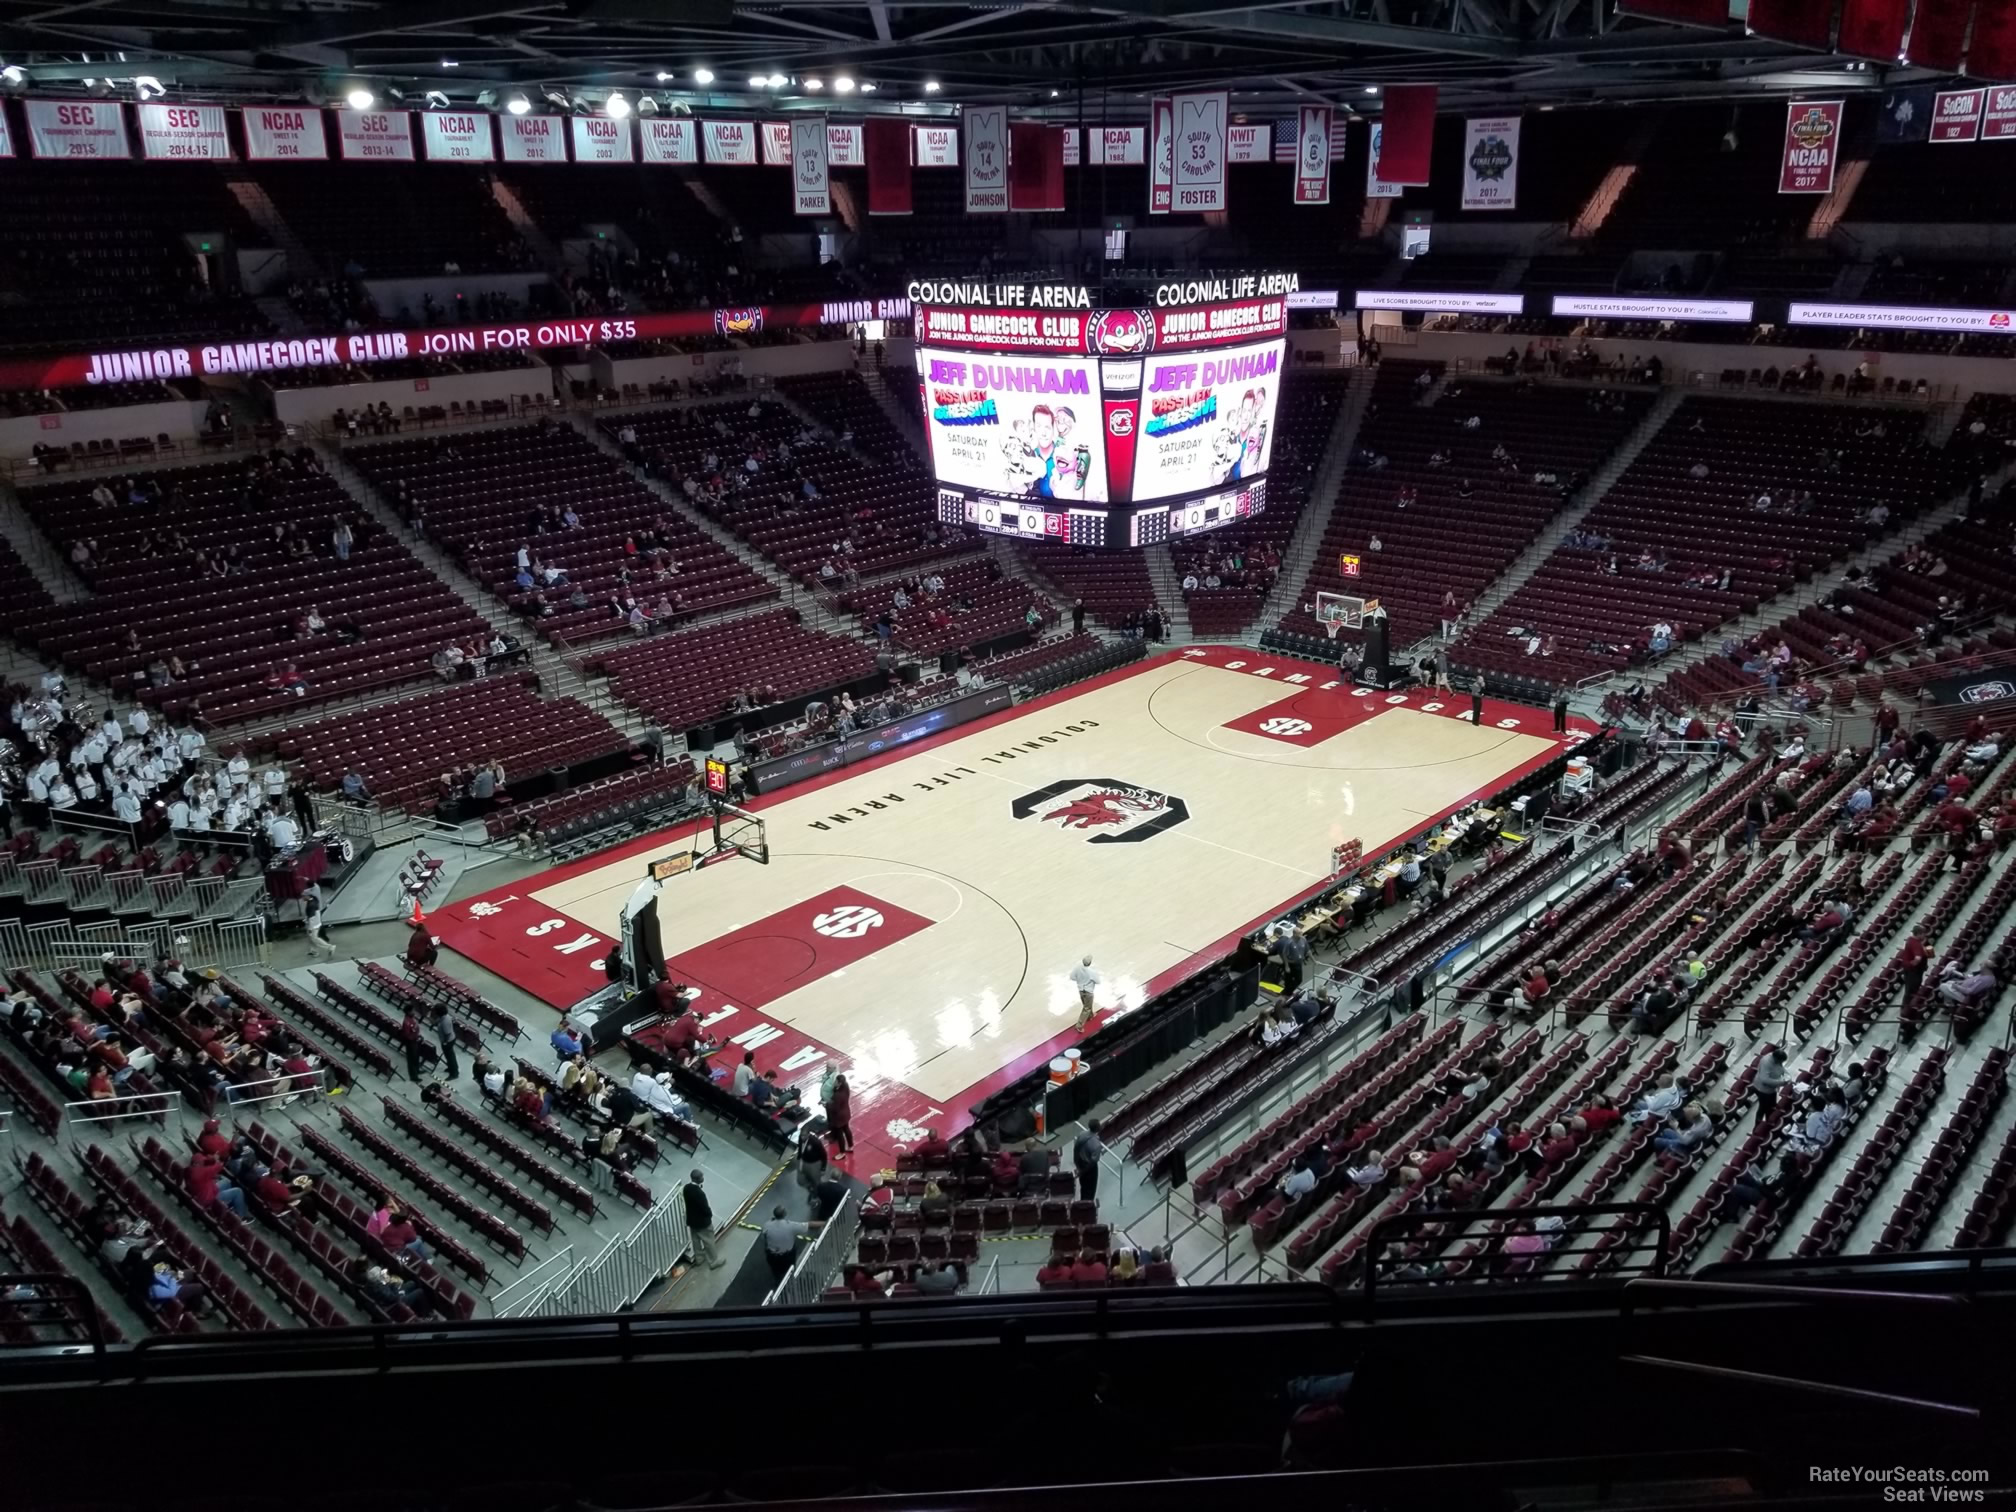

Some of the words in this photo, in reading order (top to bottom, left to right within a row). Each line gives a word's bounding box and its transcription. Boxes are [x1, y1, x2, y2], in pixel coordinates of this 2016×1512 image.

[57, 105, 95, 125] SEC
[168, 109, 200, 128] SEC
[262, 112, 305, 131] NCAA
[361, 115, 389, 132] SEC
[439, 116, 476, 133] NCAA
[515, 119, 550, 135] NCAA
[586, 120, 618, 137] NCAA
[653, 123, 683, 138] NCAA
[716, 125, 744, 141] NCAA
[828, 128, 853, 143] NCAA
[927, 131, 949, 145] NCAA
[1105, 130, 1131, 144] NCAA
[1187, 130, 1212, 144] SOUTH
[1230, 129, 1256, 142] NWIT
[69, 143, 96, 154] 2015
[169, 145, 209, 155] 2014-15
[277, 145, 299, 155] 2014
[362, 145, 394, 155] 2013-14
[451, 147, 470, 156] 2013
[526, 148, 545, 158] 2012
[596, 149, 613, 158] 2003
[976, 141, 996, 152] SOUTH
[1192, 145, 1206, 159] 53
[662, 150, 679, 159] 2002
[724, 152, 738, 161] 1991
[801, 149, 818, 160] SOUTH
[980, 153, 992, 166] 14
[1788, 149, 1828, 167] NCAA
[806, 160, 815, 172] 13
[1181, 160, 1216, 176] CAROLINA
[973, 166, 1000, 181] CAROLINA
[1795, 177, 1817, 186] 2017
[969, 193, 1005, 206] JOHNSON
[1180, 190, 1217, 204] FOSTER
[1480, 188, 1498, 197] 2017
[800, 196, 826, 208] PARKER
[907, 281, 991, 305] COLONIAL
[995, 285, 1025, 307] LIFE
[1029, 285, 1090, 308] ARENA
[1155, 278, 1230, 307] COLONIAL
[1232, 276, 1255, 299] LIFE
[1257, 272, 1299, 296] ARENA
[820, 301, 873, 325] JUNIOR
[1161, 311, 1206, 334] JUNIOR
[1209, 305, 1260, 330] GAMECOCK
[1262, 302, 1281, 323] CLUB
[1802, 311, 1833, 319] PLAYER
[1834, 312, 1866, 320] LEADER
[1867, 313, 1893, 321] STATS
[1894, 315, 1934, 323] BROUGHT
[1950, 317, 1969, 325] YOU
[928, 312, 966, 332] JUNIOR
[969, 314, 1038, 337] GAMECOCK
[1042, 317, 1080, 337] CLUB
[974, 334, 1011, 344] GAMECOCK
[1011, 336, 1028, 345] CLUB
[1029, 337, 1045, 346] FOR
[1045, 338, 1065, 347] ONLY
[1065, 338, 1080, 347] $35
[1162, 335, 1178, 344] JOIN
[1178, 332, 1191, 342] THE
[86, 347, 192, 385] JUNIOR
[201, 337, 341, 375] GAMECOCK
[348, 332, 408, 363] CLUB
[419, 332, 475, 354] JOIN
[483, 328, 530, 349] FOR
[537, 323, 594, 345] ONLY
[600, 321, 636, 342] $35
[928, 359, 968, 386] JEFF
[972, 364, 1091, 395] DUNHAM
[1105, 373, 1135, 381] verizon
[1148, 363, 1198, 393] JEFF
[1202, 349, 1278, 387] DUNHAM
[947, 433, 988, 448] SATURDAY
[1158, 438, 1203, 454] SATURDAY
[952, 448, 974, 460] APRIL
[976, 451, 986, 461] 21
[1160, 455, 1185, 468] APRIL
[1187, 453, 1197, 464] 21
[985, 509, 994, 523] 0
[1224, 502, 1232, 516] 0
[1027, 515, 1037, 530] 0
[1191, 511, 1199, 525] 0
[1344, 563, 1357, 575] 30
[1259, 717, 1314, 737] SEC
[981, 720, 1100, 765] COLONIAL
[823, 756, 839, 767] BUICK
[709, 771, 724, 789] 30
[912, 767, 976, 792] LIFE
[808, 793, 906, 832] ARENA
[812, 905, 885, 938] SEC
